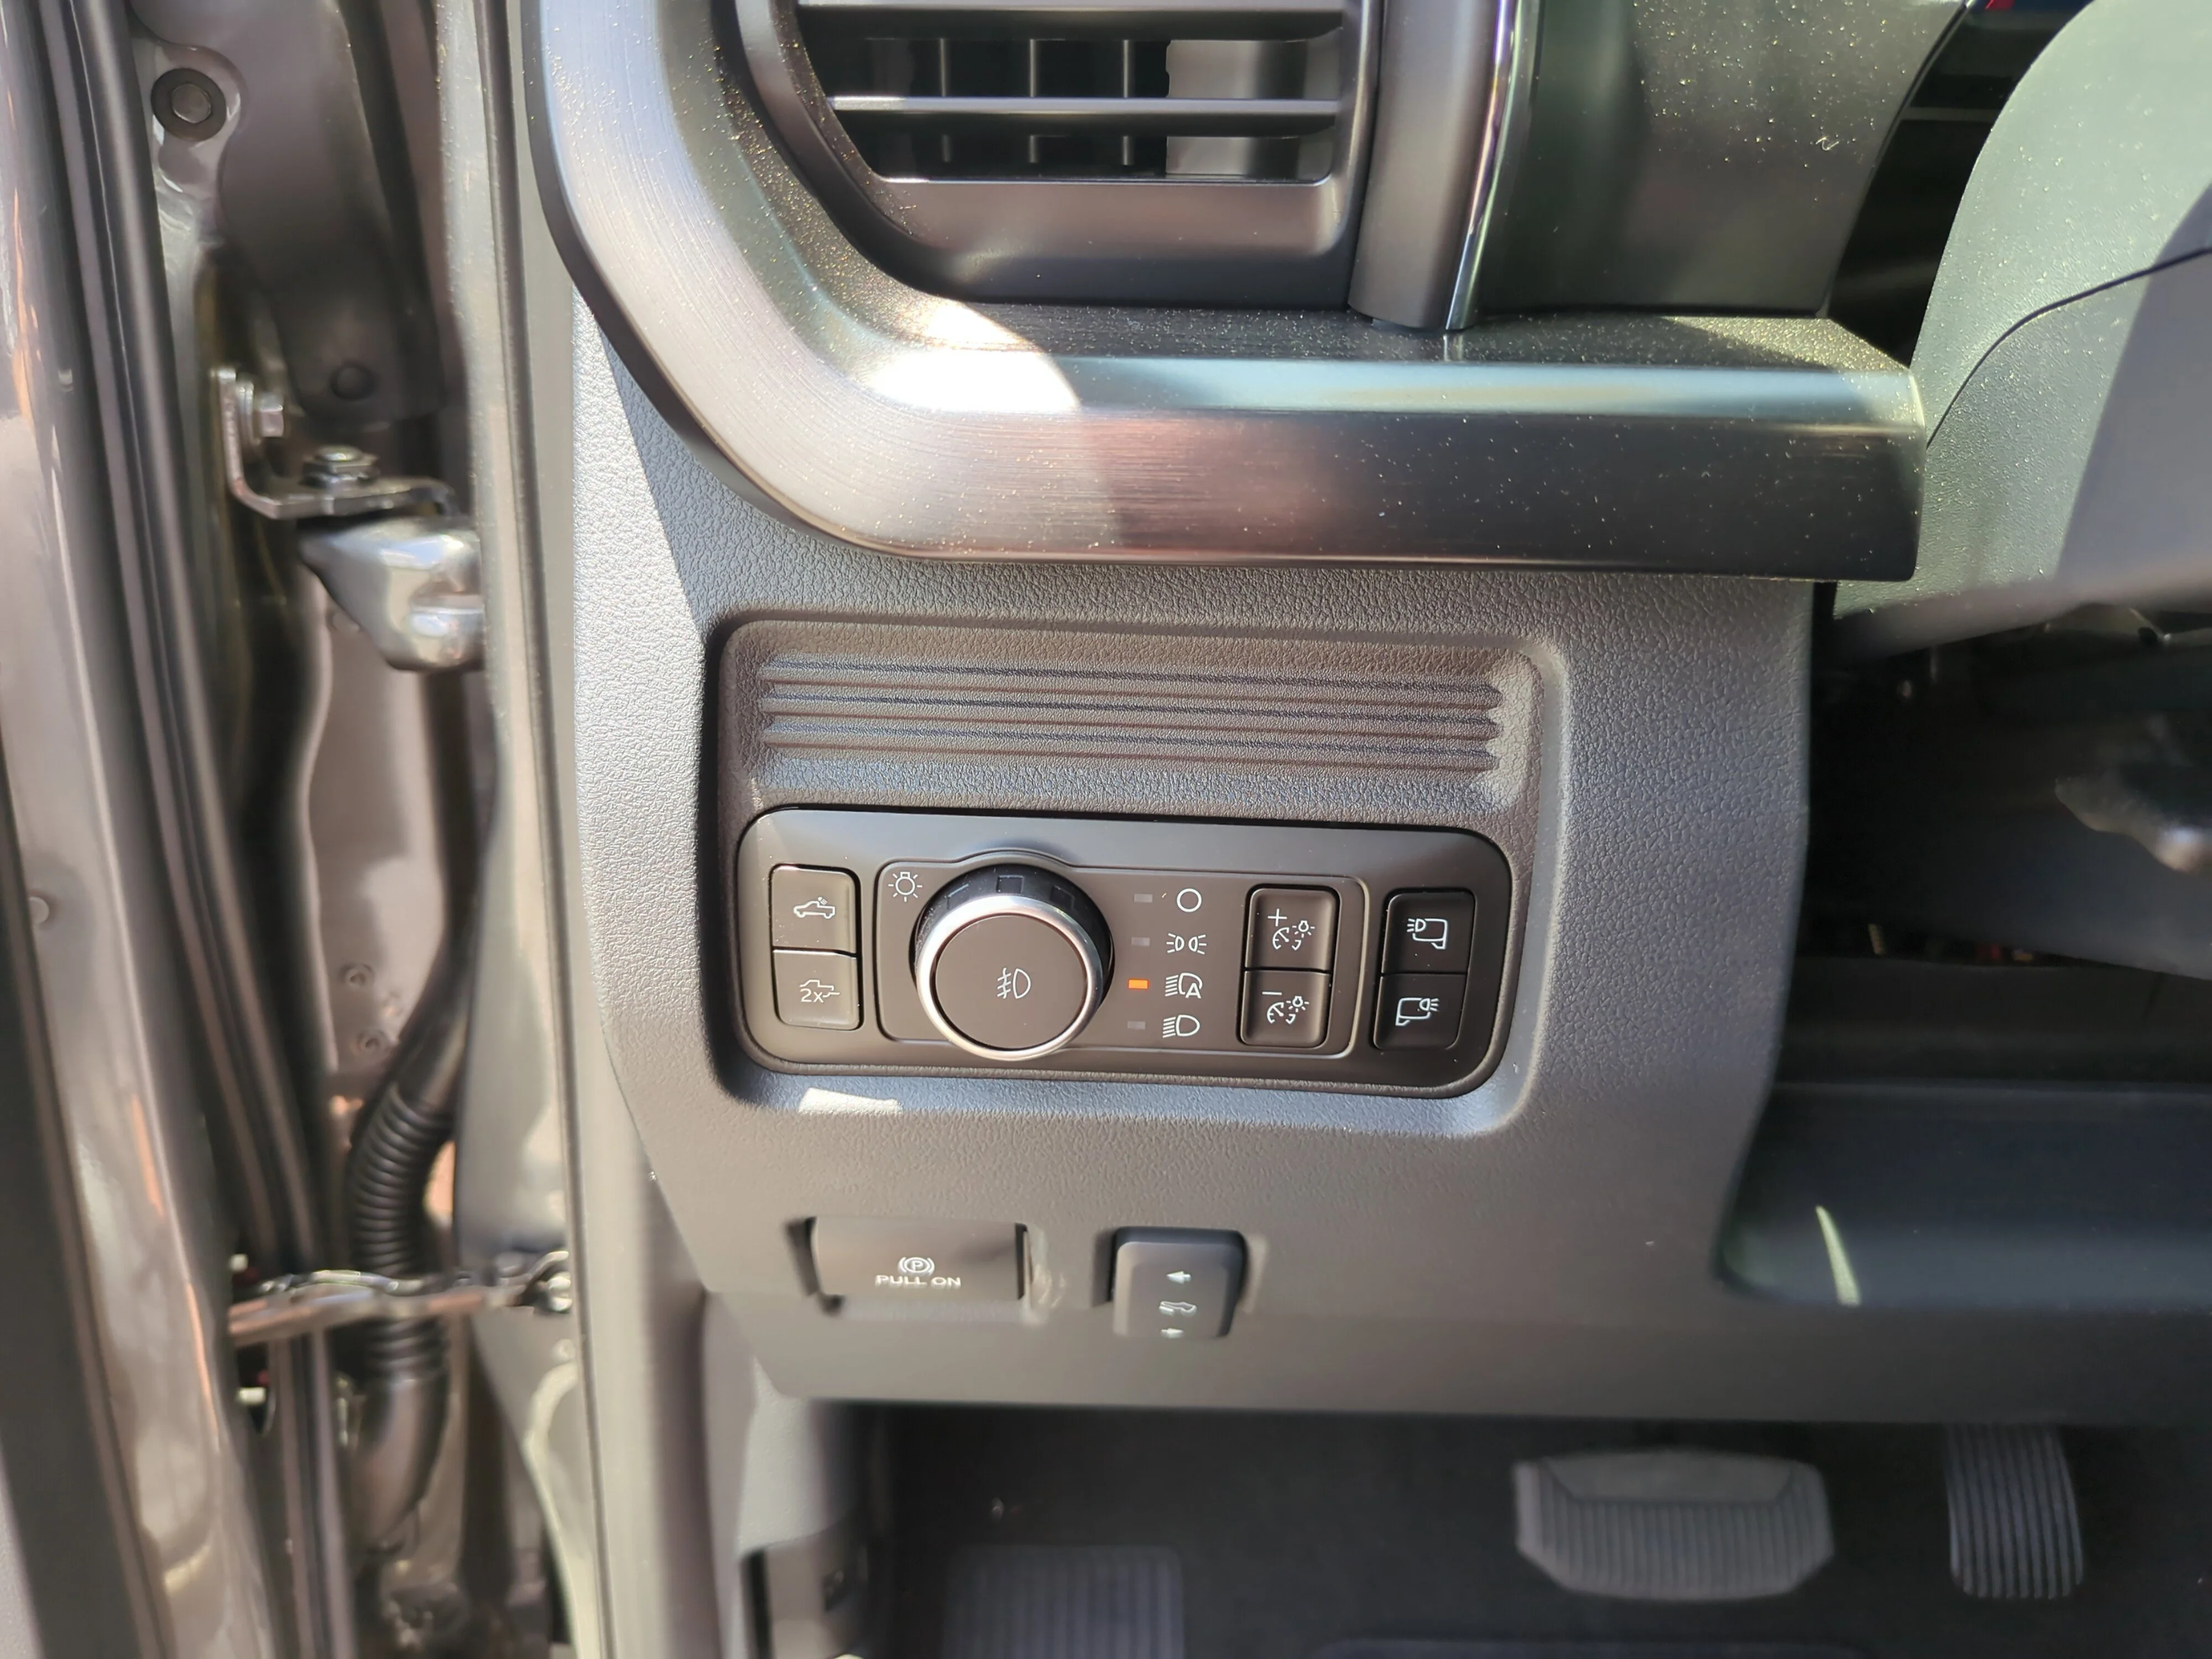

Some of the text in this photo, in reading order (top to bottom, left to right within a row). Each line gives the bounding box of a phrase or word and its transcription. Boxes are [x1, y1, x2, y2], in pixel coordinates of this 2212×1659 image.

[800, 988, 824, 1003] 2x
[1185, 983, 1201, 999] A
[875, 1274, 961, 1289] PULL ON
